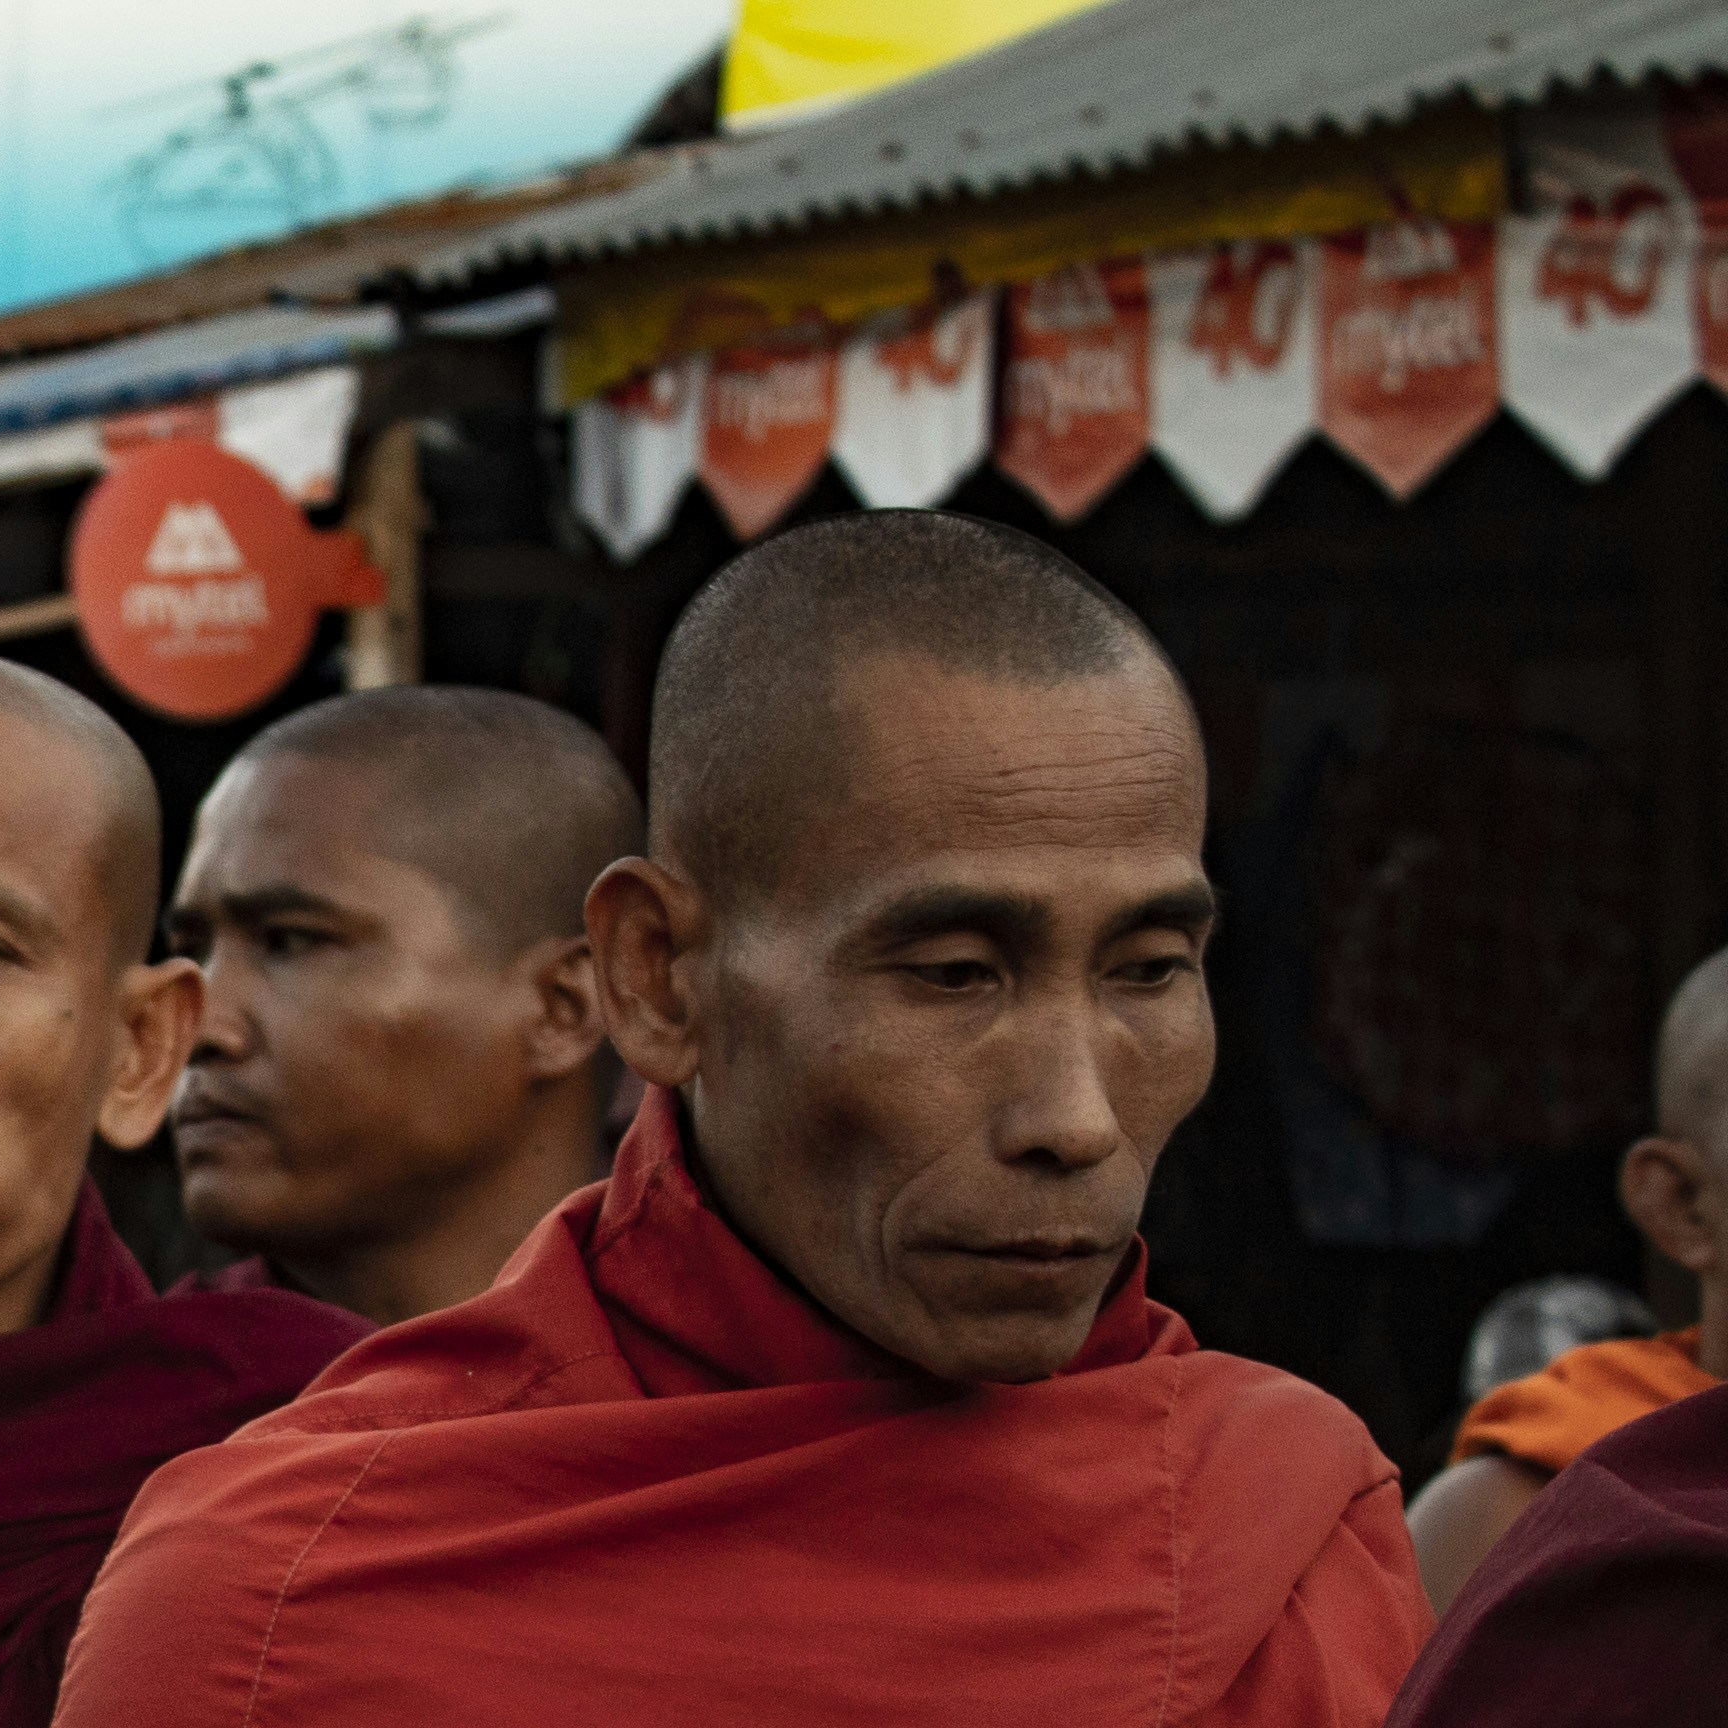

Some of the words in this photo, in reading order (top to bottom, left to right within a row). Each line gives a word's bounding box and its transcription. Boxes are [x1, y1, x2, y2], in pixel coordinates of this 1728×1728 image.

[1538, 180, 1666, 332] 40
[1189, 245, 1296, 382] 40
[1330, 275, 1486, 394] mytel
[714, 352, 832, 446] mytel
[1008, 334, 1144, 438] mytel
[120, 568, 271, 636] mytel
